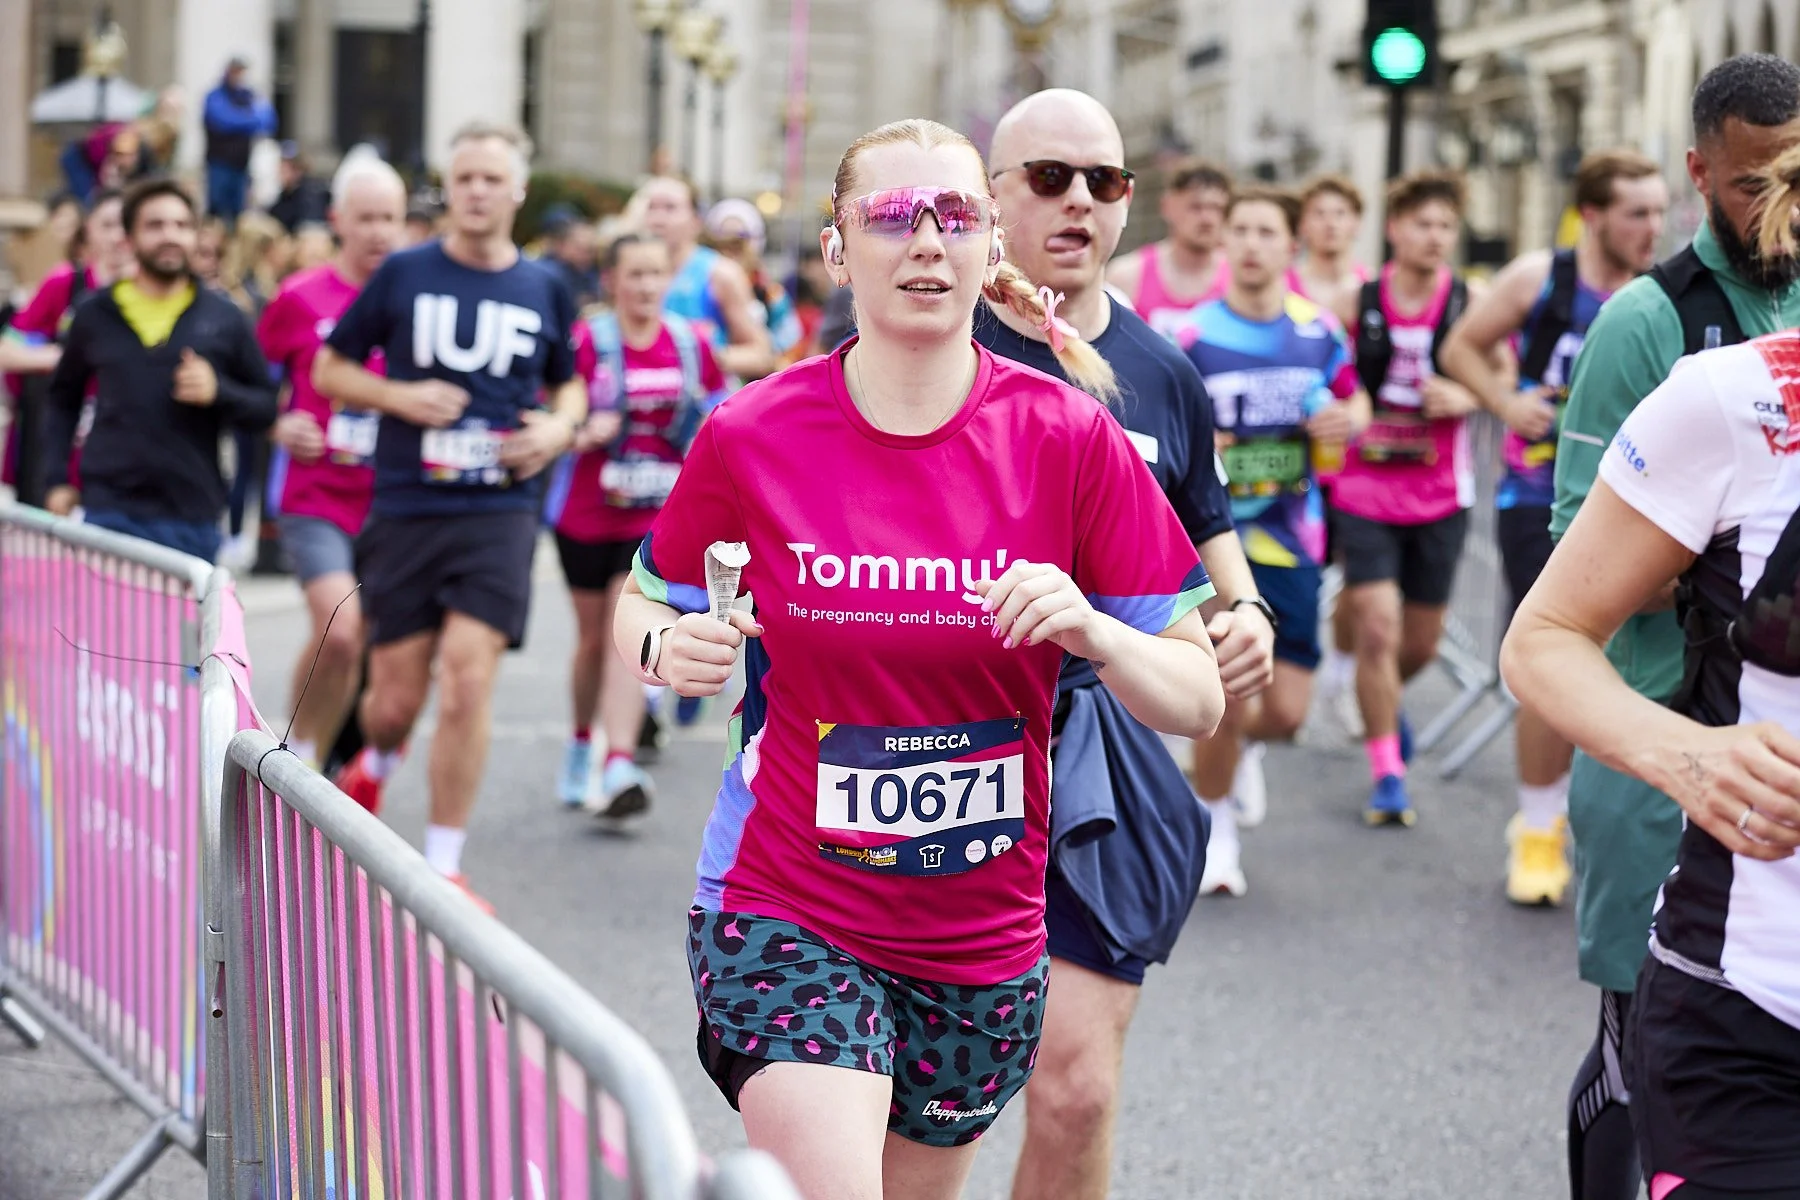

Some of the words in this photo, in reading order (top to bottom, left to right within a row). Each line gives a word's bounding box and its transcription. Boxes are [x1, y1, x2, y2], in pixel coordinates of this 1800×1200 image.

[413, 293, 542, 378] IUF
[786, 542, 1028, 605] Tommy'
[787, 602, 808, 618] The
[811, 609, 894, 626] pregnancy
[899, 609, 930, 624] and
[935, 610, 976, 628] baby
[885, 733, 971, 752] REBECCA
[835, 763, 1005, 825] 10671
